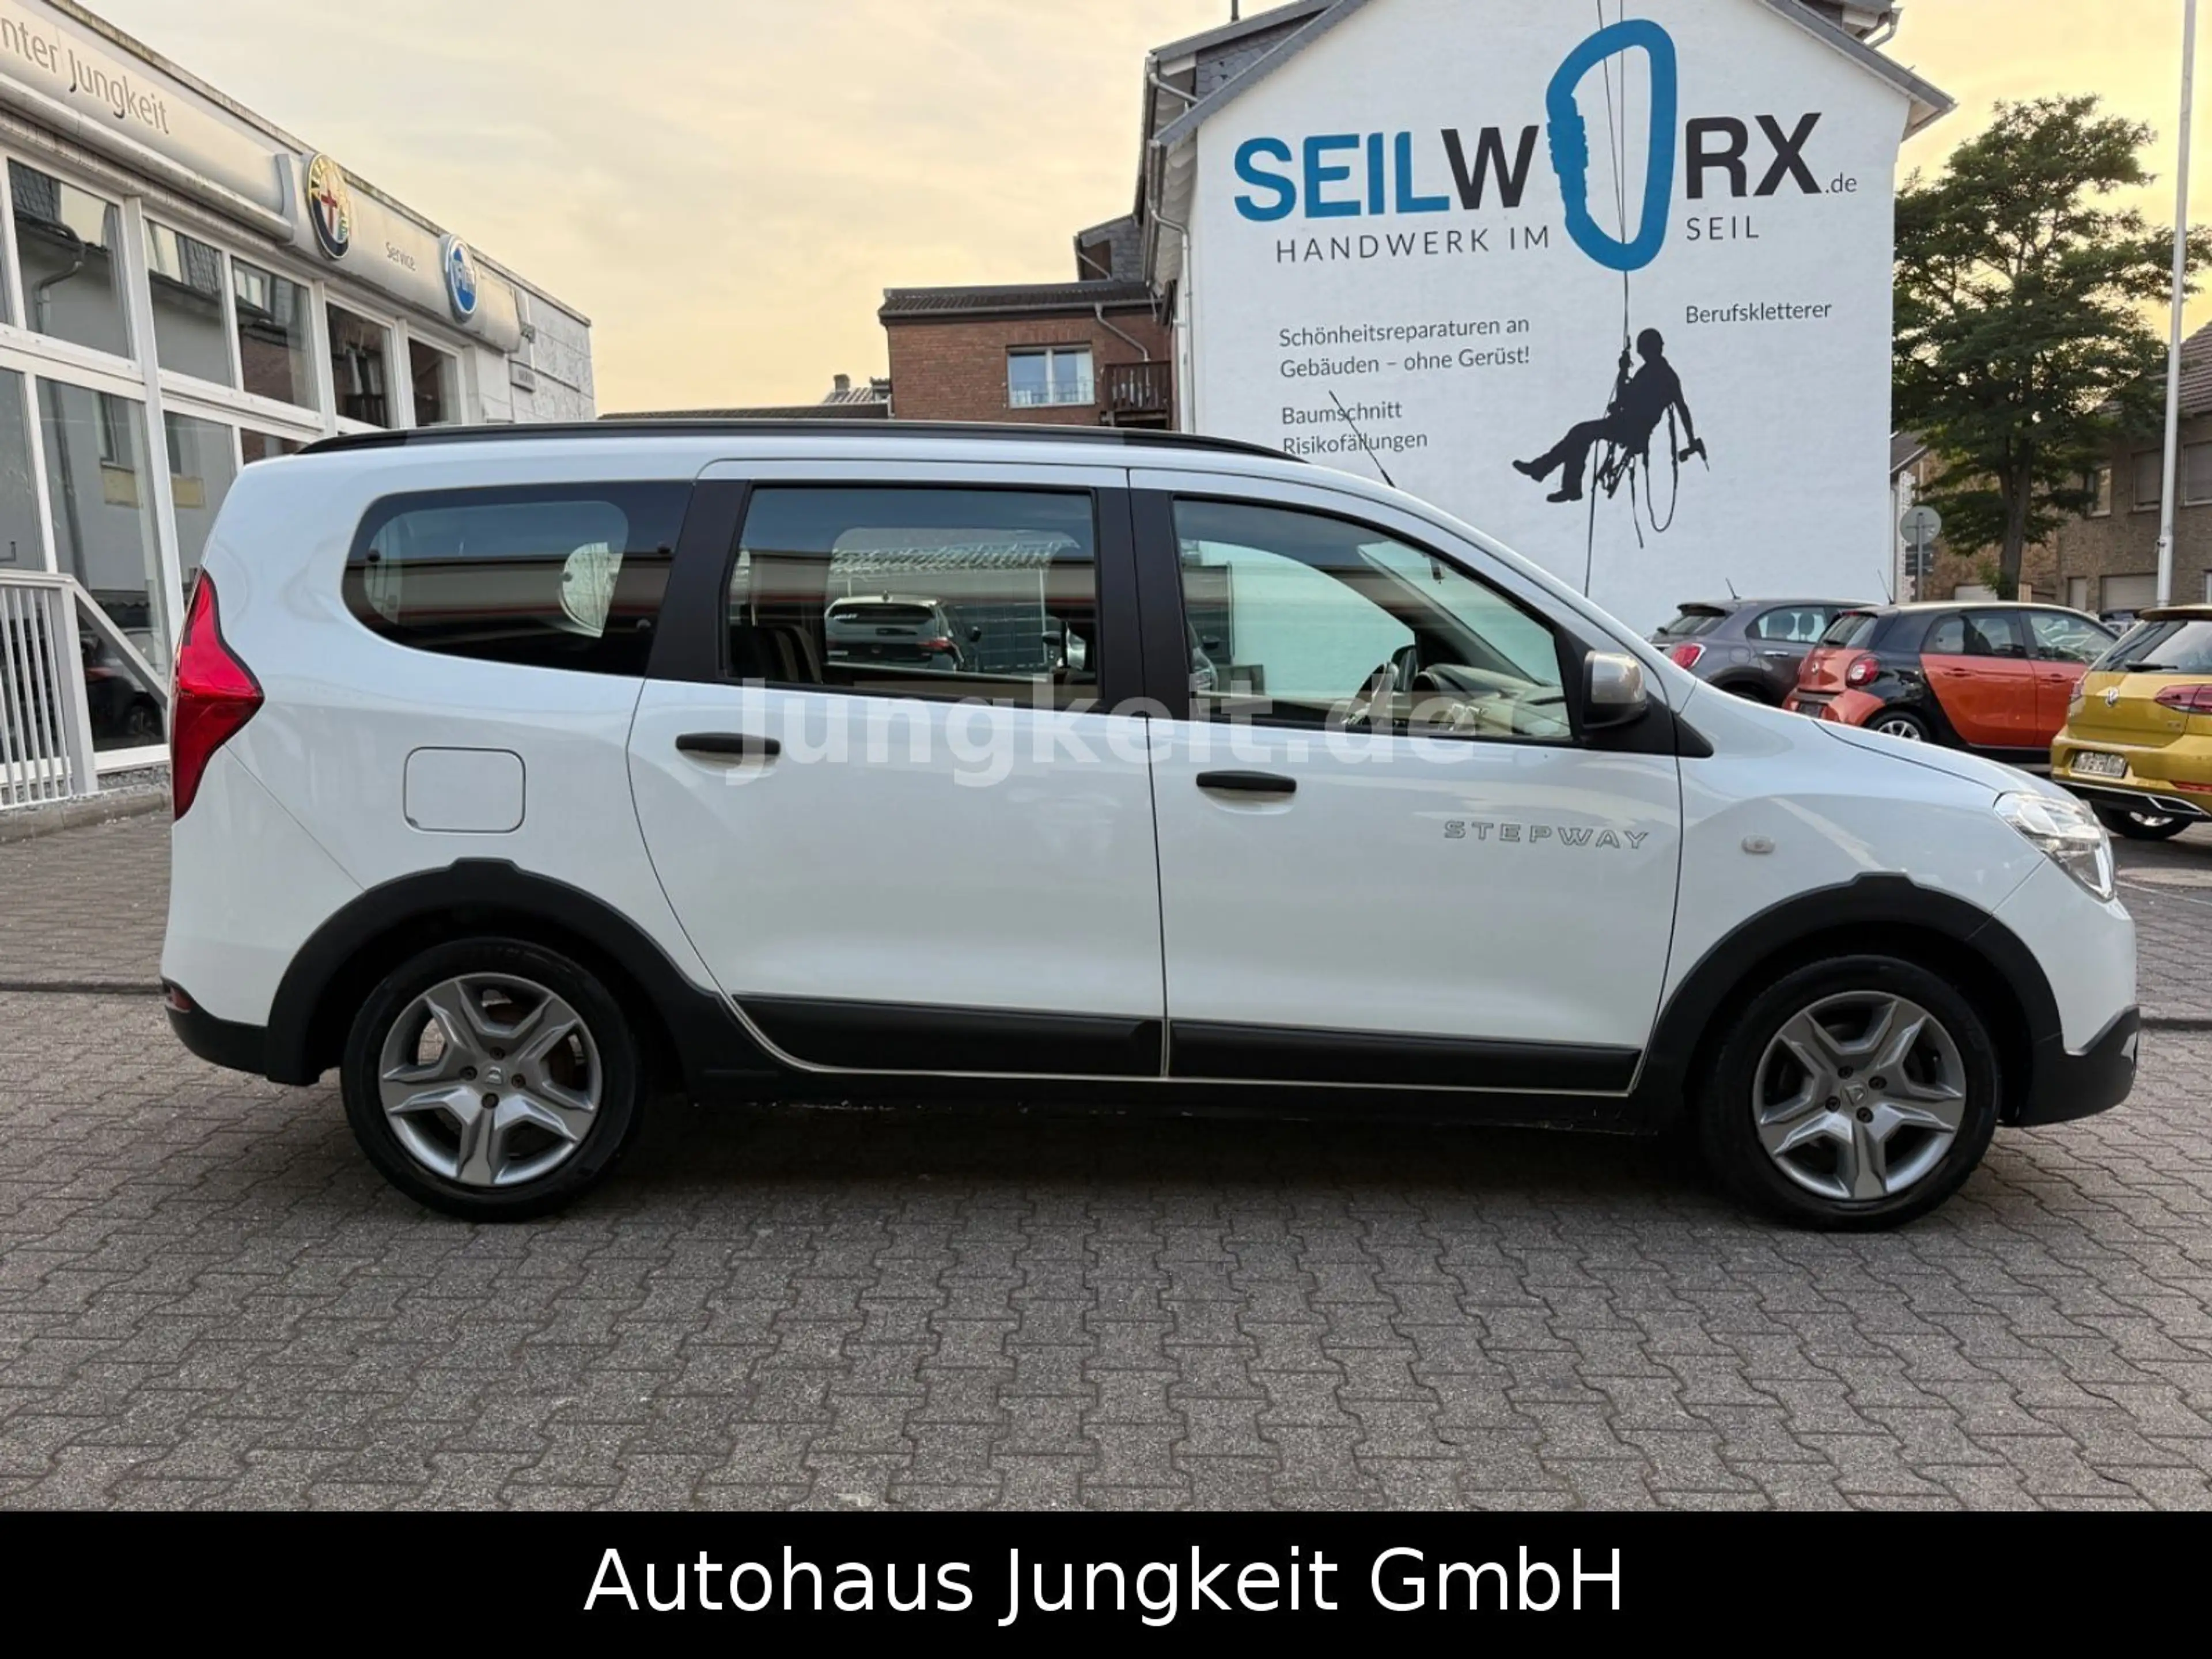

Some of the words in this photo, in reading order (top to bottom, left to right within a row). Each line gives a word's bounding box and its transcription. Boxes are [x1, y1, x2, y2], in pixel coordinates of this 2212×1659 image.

[68, 48, 169, 134] Jungkeit
[1276, 228, 1489, 263] HANDWERK
[1510, 225, 1550, 250] IM
[1685, 215, 1760, 240] SEIL
[385, 241, 416, 272] Service
[1685, 301, 1832, 324] Berufskletterer
[1279, 319, 1500, 347] Schönheitsreparaturen
[1506, 318, 1530, 334] an
[1281, 357, 1380, 378] Gebäuden
[1404, 351, 1453, 372] ohne
[1458, 346, 1530, 368] Gerüst!
[1282, 401, 1403, 425] Baumschnitt
[1283, 432, 1428, 455] Risikofällungen
[1444, 820, 1649, 850] STEPWAY
